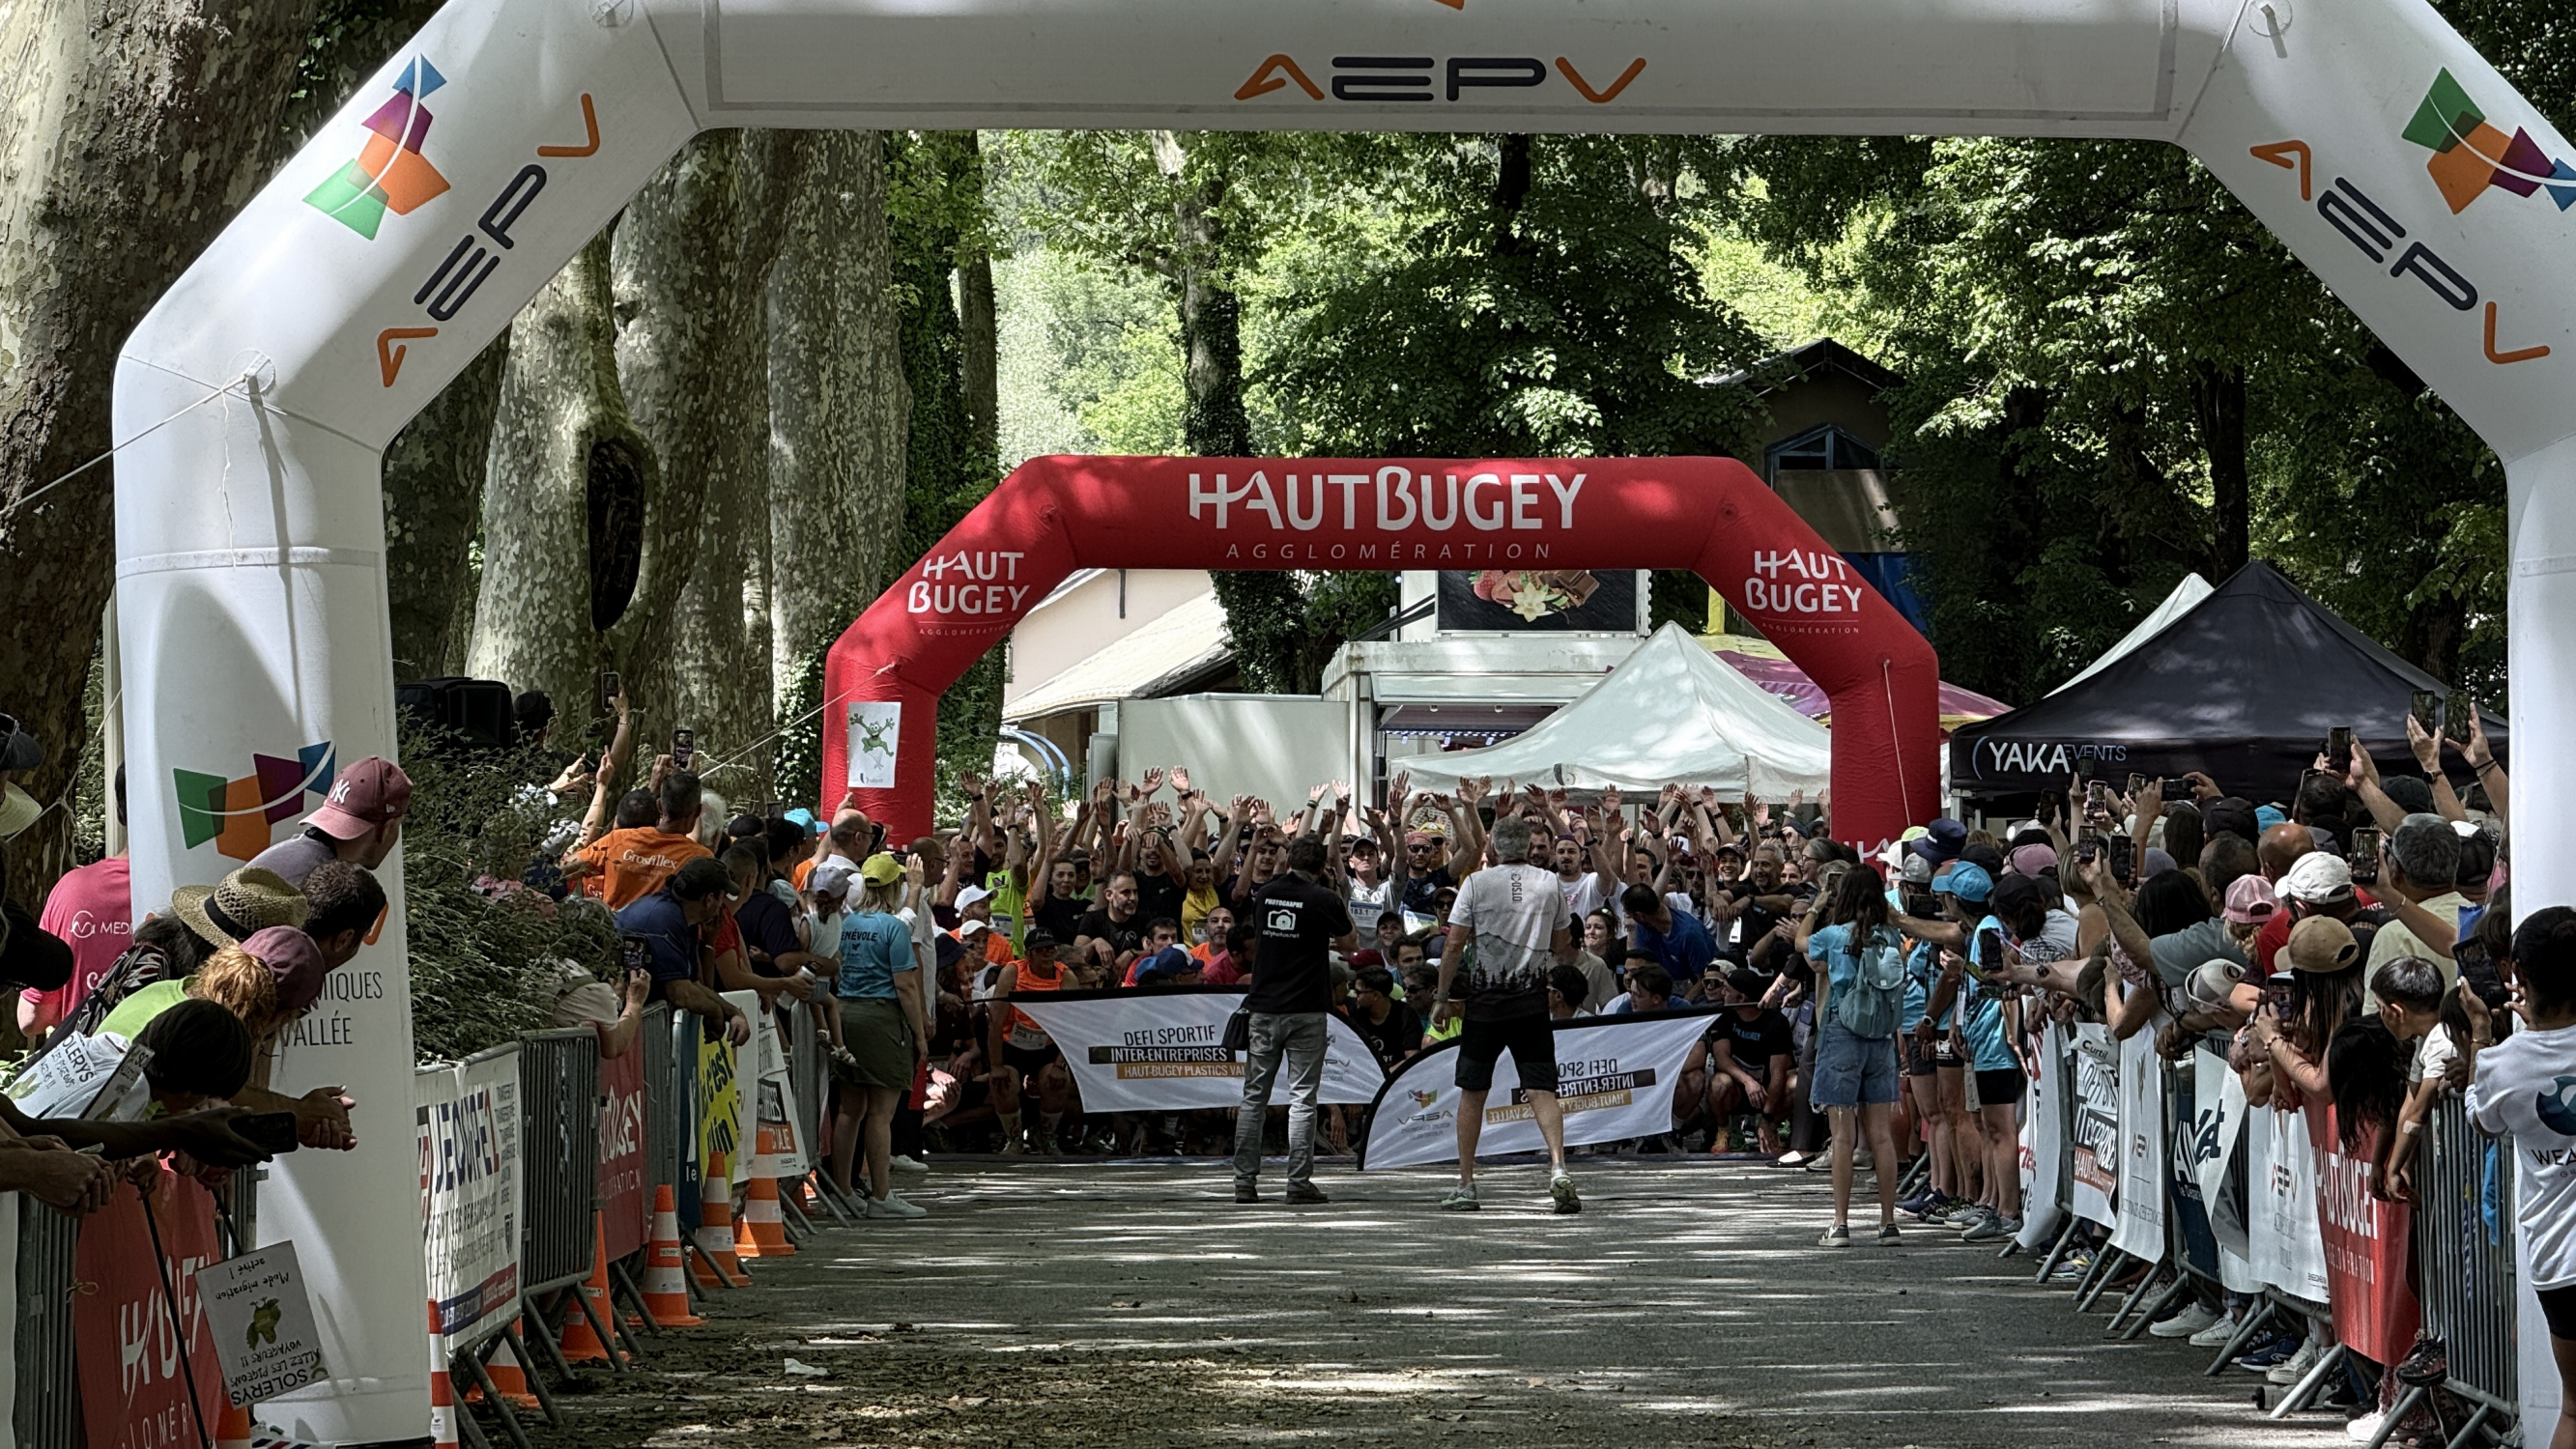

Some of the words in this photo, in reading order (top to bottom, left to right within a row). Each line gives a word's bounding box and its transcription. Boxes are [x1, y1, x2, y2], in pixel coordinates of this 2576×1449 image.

[1234, 54, 1646, 103] AEPV
[378, 94, 599, 387] AEPV
[2249, 139, 2551, 365] AEPV
[1226, 541, 1550, 559] AGGLOMÉRATION
[922, 551, 1024, 581] HAUT
[1754, 548, 1846, 581] HAUT
[907, 581, 1030, 614] BUGEY
[1744, 578, 1862, 612] BUGEY
[1989, 742, 2071, 773] YAKA
[622, 849, 678, 868] Grosfillex
[1265, 898, 1303, 909] PHOTOGRAPHE
[841, 928, 878, 942] ÉNÉVOLE
[1124, 1030, 1154, 1046] DEFI
[1158, 1025, 1216, 1044] SPORTIF
[62, 1035, 95, 1083] OLERYS
[1111, 1047, 1227, 1063] INTER-ENTREPRISES
[2082, 1039, 2109, 1060] Curtil
[1185, 1065, 1228, 1077] PLASTICS
[1230, 1065, 1246, 1076] VAL
[215, 1280, 259, 1300] migration
[262, 1271, 289, 1288] Mode
[251, 1339, 301, 1363] VOYAGEURS
[272, 1359, 288, 1372] LES
[230, 1367, 269, 1388] PIGEONS
[231, 1368, 308, 1406] SOLERYS
